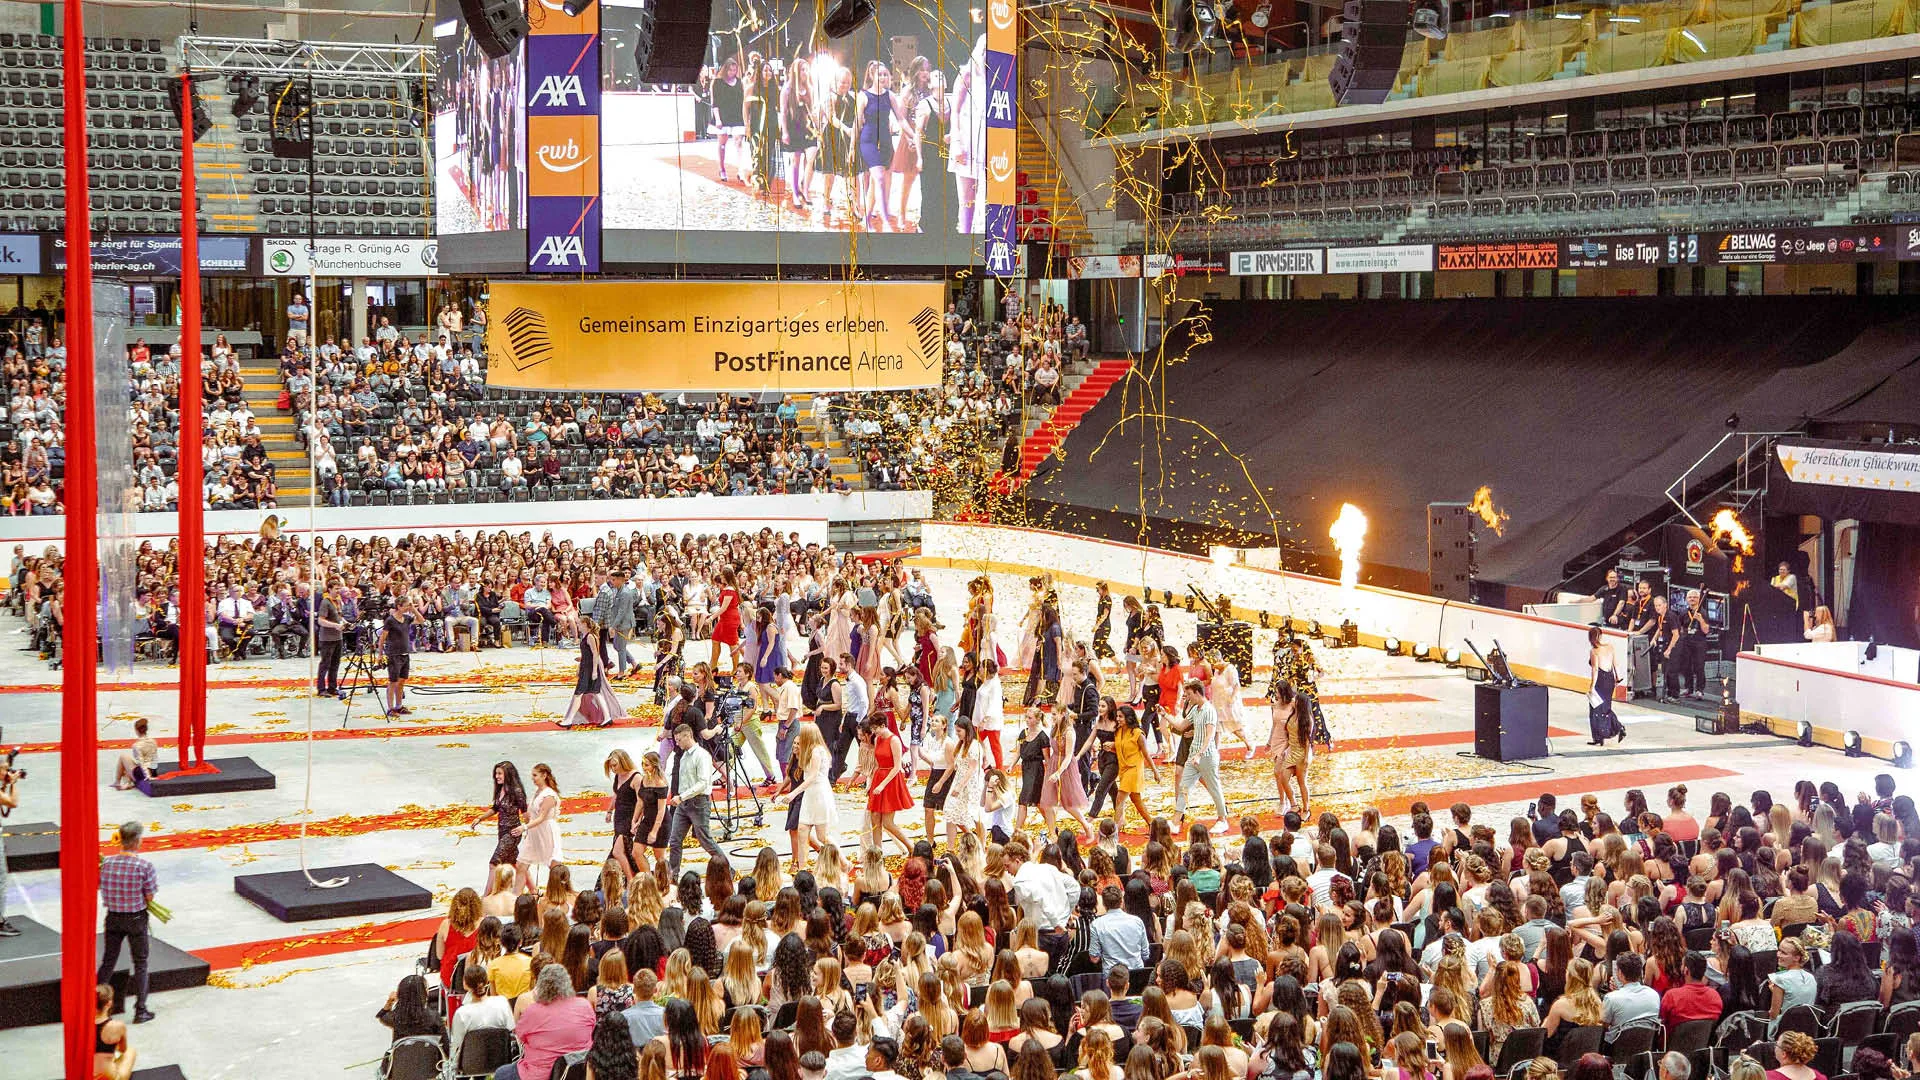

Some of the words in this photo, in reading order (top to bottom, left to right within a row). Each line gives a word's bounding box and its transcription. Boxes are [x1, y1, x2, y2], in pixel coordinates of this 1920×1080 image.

[529, 75, 587, 107] AXA
[987, 90, 1011, 121] AXA
[536, 139, 580, 164] ewb
[101, 240, 127, 250] sorgt
[130, 240, 145, 248] für
[344, 245, 355, 253] R.
[358, 244, 391, 255] Grünig
[393, 244, 410, 253] AG
[1731, 234, 1776, 250] BELWAG
[1806, 240, 1825, 252] Jeep
[530, 236, 587, 266] AXA
[986, 242, 1011, 271] AXA
[1518, 251, 1557, 266] MAXX
[1616, 244, 1634, 260] üse
[1636, 243, 1659, 263] Tipp
[200, 259, 246, 267] SCHERLER
[314, 259, 401, 269] Münchenbuchsee
[1256, 253, 1315, 272] RAMSEIER
[1440, 253, 1475, 268] MAXX
[1479, 252, 1515, 267] MAXX
[579, 315, 686, 333] Gemeinsam
[694, 316, 819, 338] Einzigartiges
[825, 316, 888, 333] erleben.
[714, 351, 850, 372] PostFinance
[858, 351, 903, 371] Arena
[1802, 452, 1860, 468] Herzlichen
